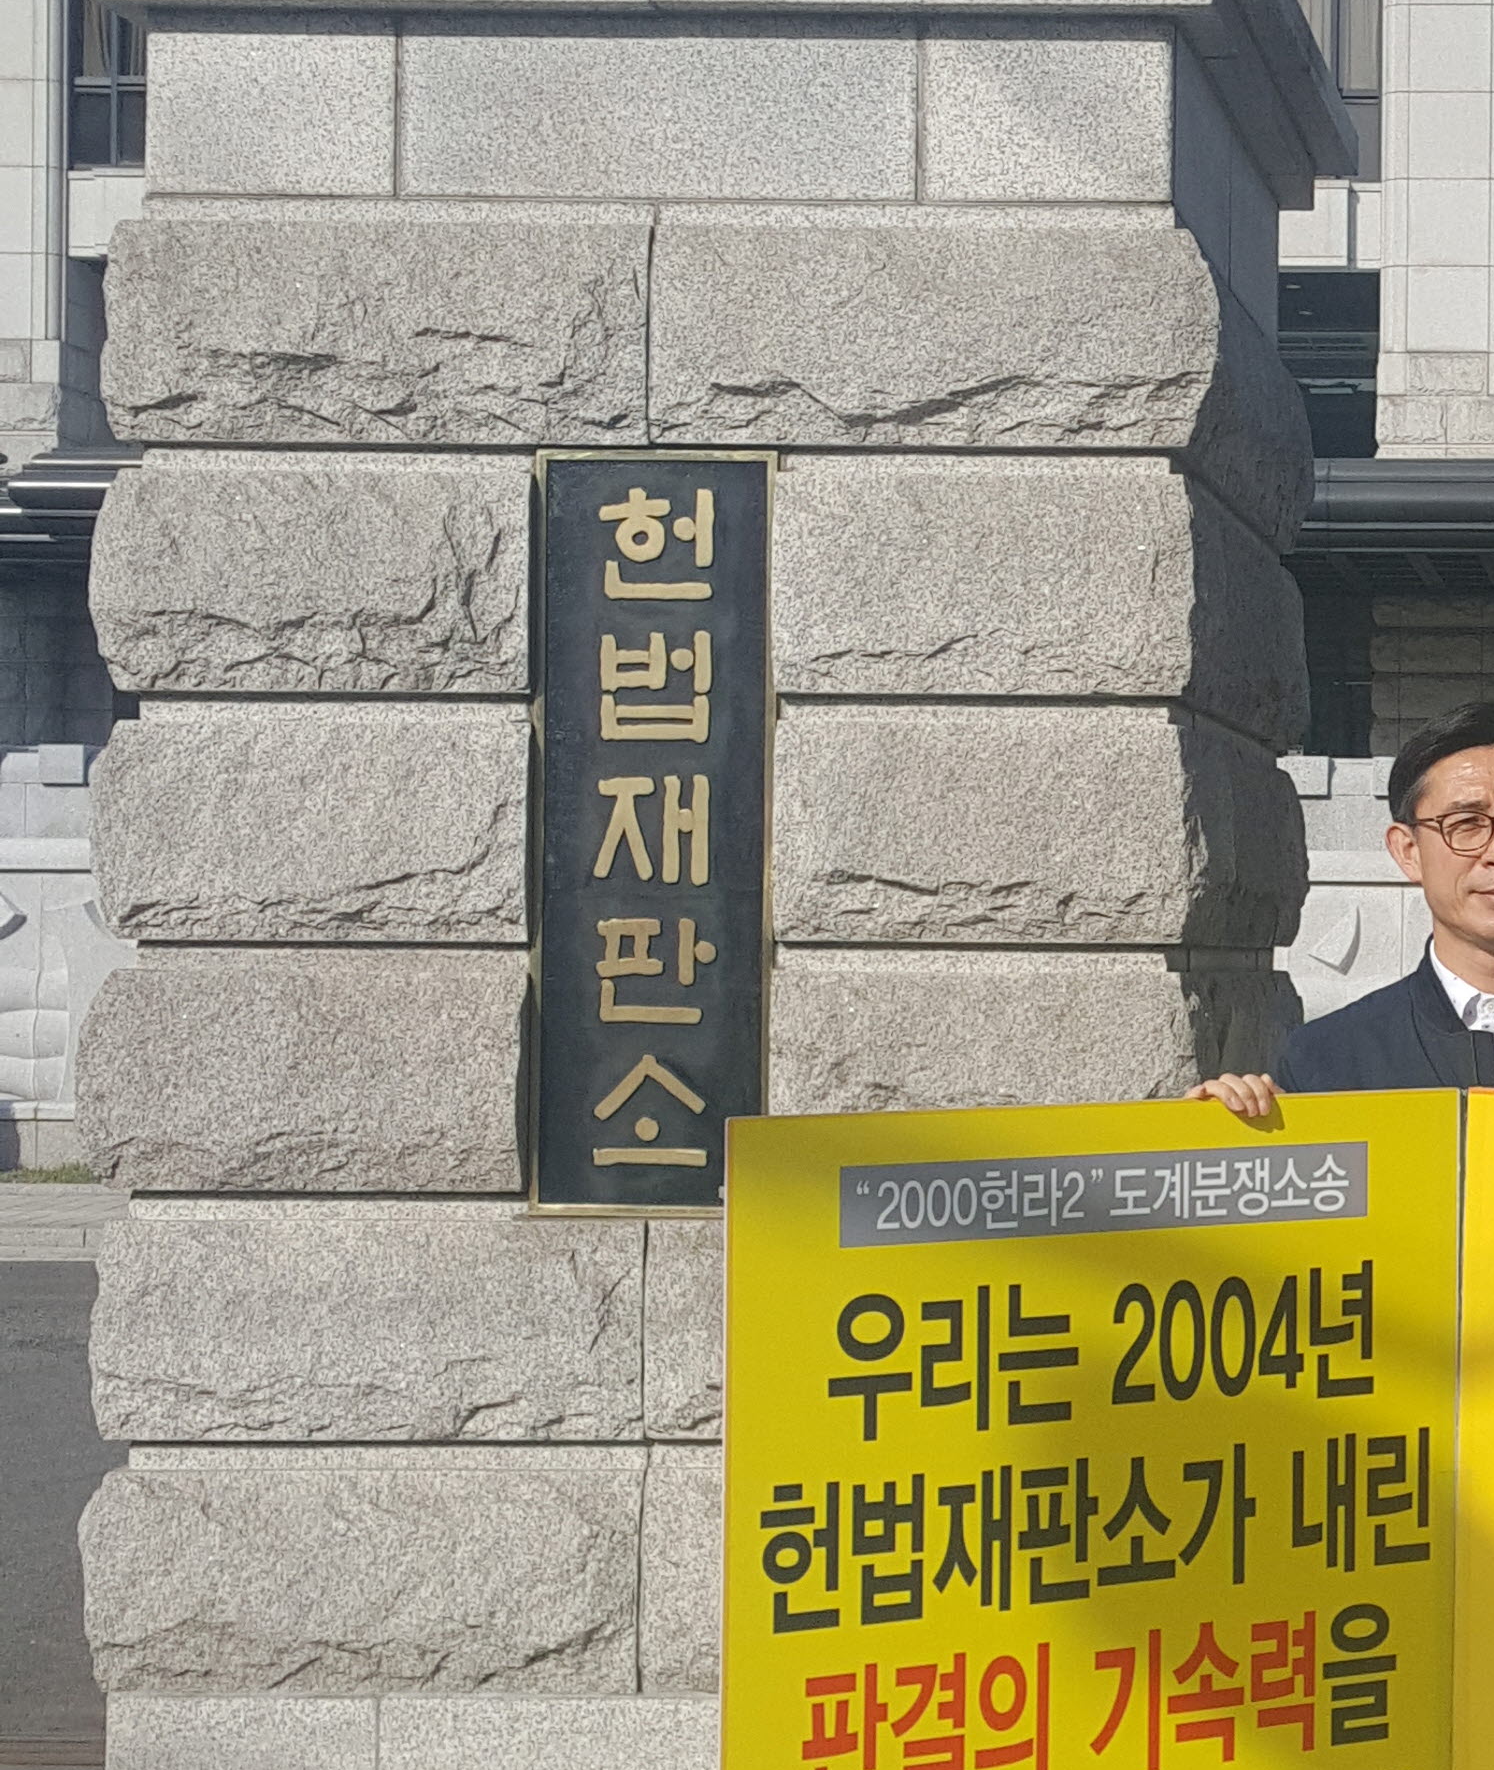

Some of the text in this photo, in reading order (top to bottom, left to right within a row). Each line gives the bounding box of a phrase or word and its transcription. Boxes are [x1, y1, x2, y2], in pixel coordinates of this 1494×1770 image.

[592, 487, 717, 1167] 헌법재판소
[1110, 1152, 1350, 1220] 도계분쟁소송
[829, 1260, 1373, 1441] 우리는 2004년
[760, 1428, 1430, 1634] 헌법재판소가 내린
